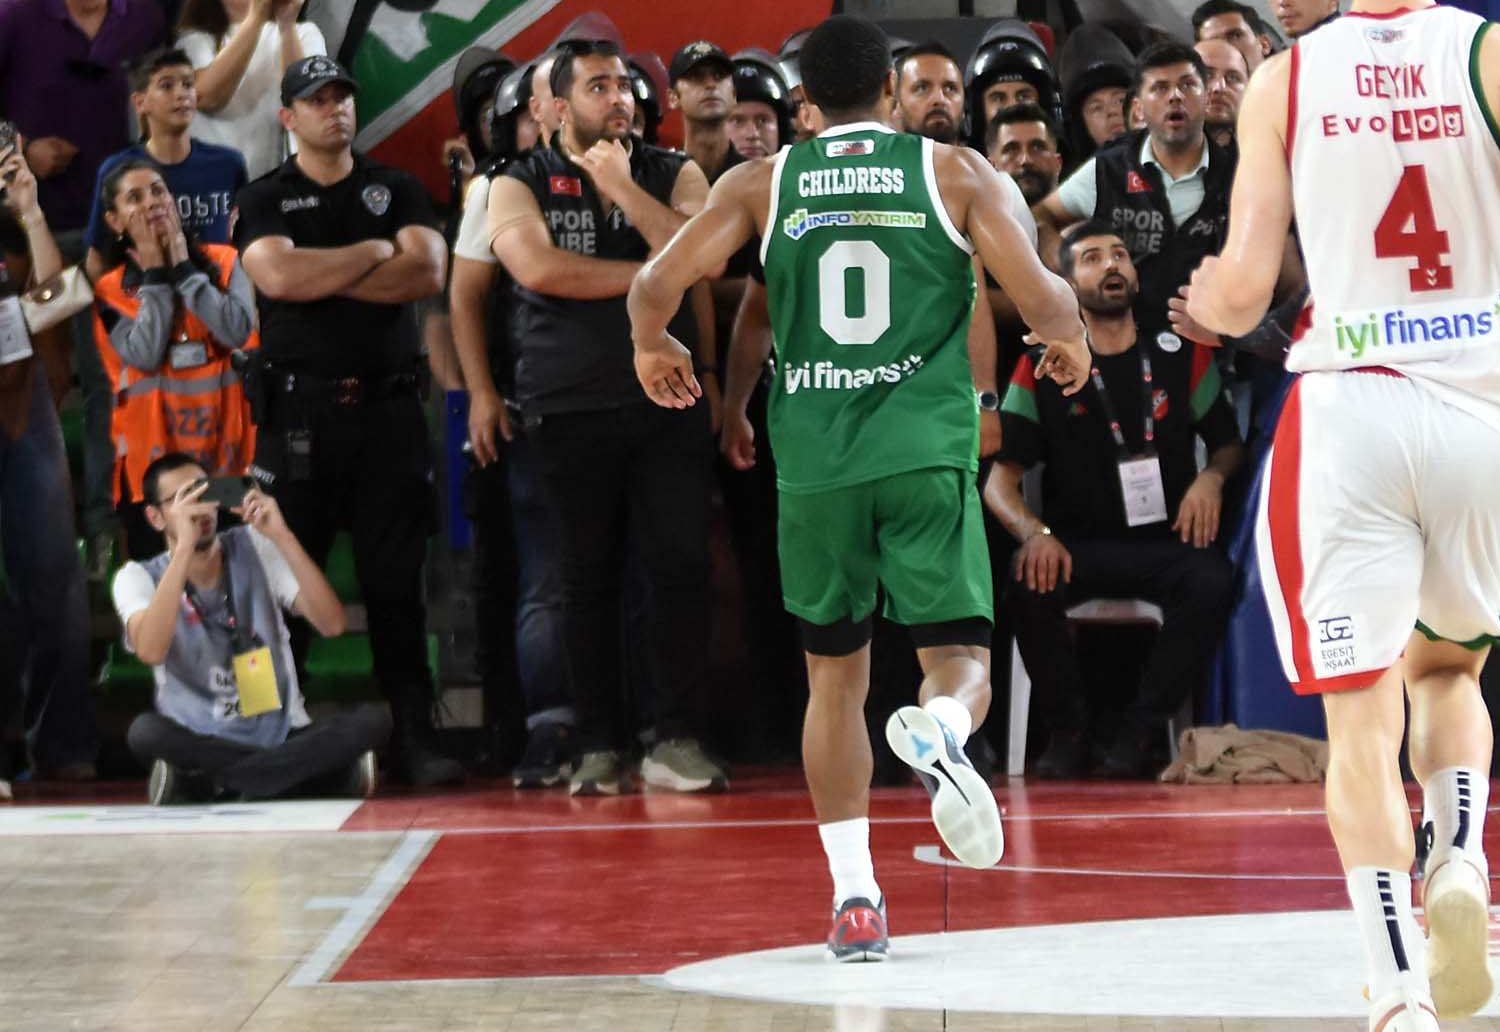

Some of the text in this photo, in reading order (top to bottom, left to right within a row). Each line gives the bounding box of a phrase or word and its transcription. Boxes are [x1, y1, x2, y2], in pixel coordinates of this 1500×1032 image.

[1355, 63, 1427, 99] GEYİK
[798, 167, 906, 198] CHILDRESS
[1112, 208, 1165, 231] SPOR
[1373, 164, 1454, 292] 4
[818, 240, 891, 345] 0
